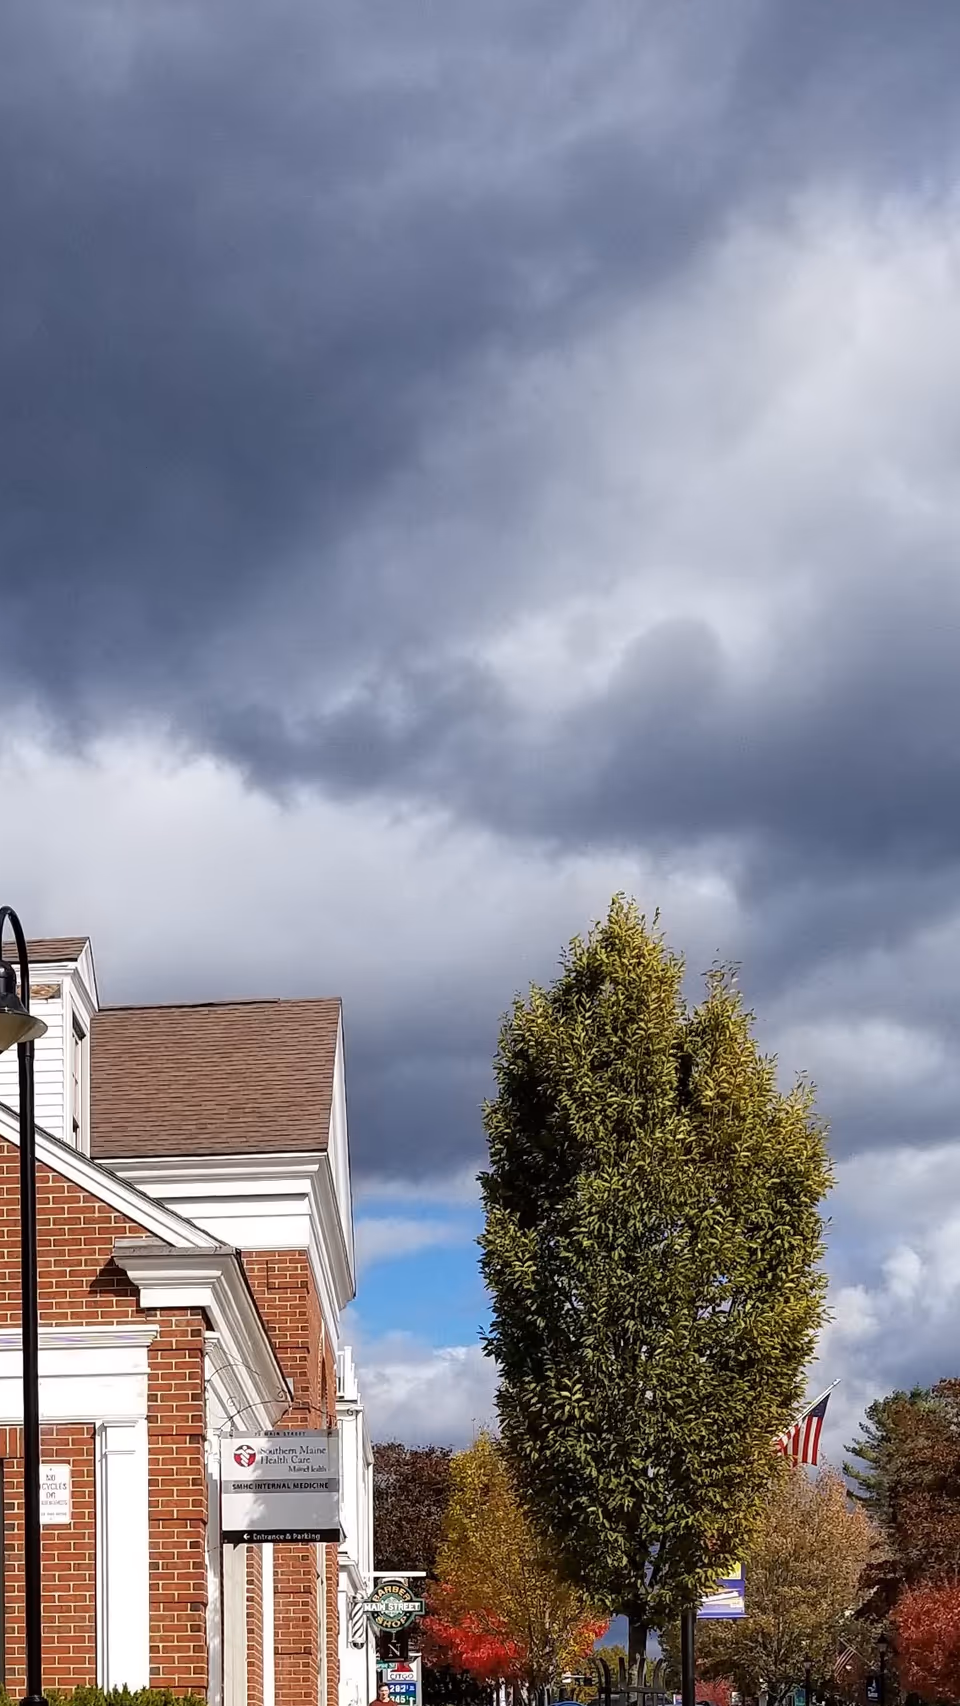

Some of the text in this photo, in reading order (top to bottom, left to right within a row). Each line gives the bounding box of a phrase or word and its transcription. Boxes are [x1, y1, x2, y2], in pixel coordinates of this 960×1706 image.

[260, 1446, 326, 1455] Southern Maine
[260, 1455, 311, 1464] Health Care
[293, 1532, 320, 1541] Parking
[372, 1586, 411, 1602] BARBER
[364, 1602, 421, 1611] MAIN STREET
[376, 1616, 407, 1627] SHOP
